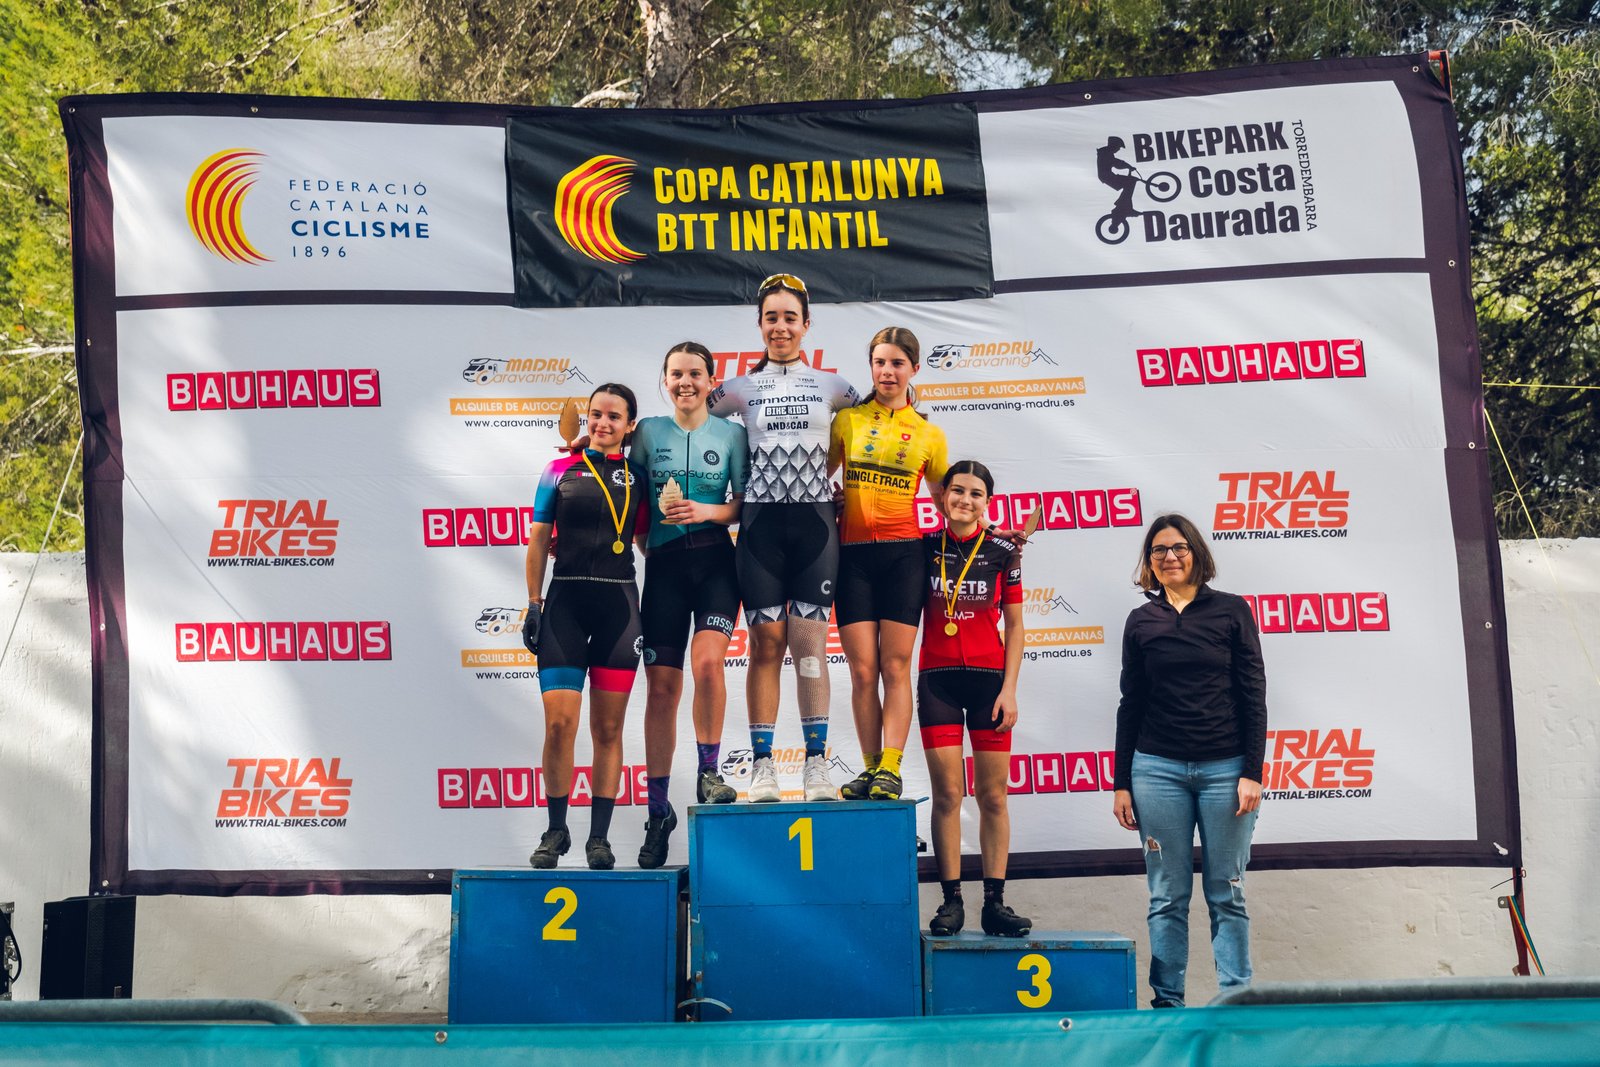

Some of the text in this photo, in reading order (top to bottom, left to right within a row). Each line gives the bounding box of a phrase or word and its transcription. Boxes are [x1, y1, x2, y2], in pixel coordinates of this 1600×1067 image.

[1132, 121, 1290, 163] BIKEPARK
[288, 179, 428, 197] FEDERACIÓ
[654, 157, 945, 204] COPA CATALUNYA
[1188, 162, 1296, 198] Costa
[1291, 119, 1318, 231] TORREDEMBARRA
[289, 199, 429, 216] CATALANA
[290, 220, 430, 239] CICLISME
[657, 208, 889, 252] BTT INFANTIL
[1142, 201, 1301, 243] Daurada
[292, 245, 347, 258] 1896
[941, 354, 1032, 371] Caravaning
[970, 341, 1034, 356] MADRU
[1142, 345, 1360, 380] BAUHAUS
[475, 370, 568, 386] Caravaning
[505, 358, 571, 372] MADRU
[171, 373, 375, 405] BAUHAUS
[748, 394, 823, 407] cannondale
[920, 381, 1085, 398] ALQUILER DE AUTOCARAVANAS
[455, 401, 503, 412] ALQUILER
[505, 401, 519, 412] DE
[931, 398, 1075, 412] www.caravaning-madru.es
[846, 469, 911, 490] SINGLETRACK
[1218, 470, 1350, 501] TRIAL
[217, 499, 340, 529] TRIAL
[917, 493, 1137, 530] BUHAUS
[1213, 500, 1349, 530] BIKES
[208, 529, 338, 557] BIKES
[1212, 529, 1348, 541] WWW.TRIAL-BIKES.COM
[207, 557, 335, 567] WWW.TRIAL-BIKES.COM
[180, 626, 387, 655] BAUHAUS
[466, 652, 531, 663] ALQUILER DE
[226, 757, 353, 788] TRIAL
[216, 788, 351, 818] BIKES
[215, 818, 347, 828] WWW.TRIAL-BIKES.COM
[788, 817, 814, 871] 1
[542, 887, 578, 942] 2
[1016, 953, 1052, 1008] 3
